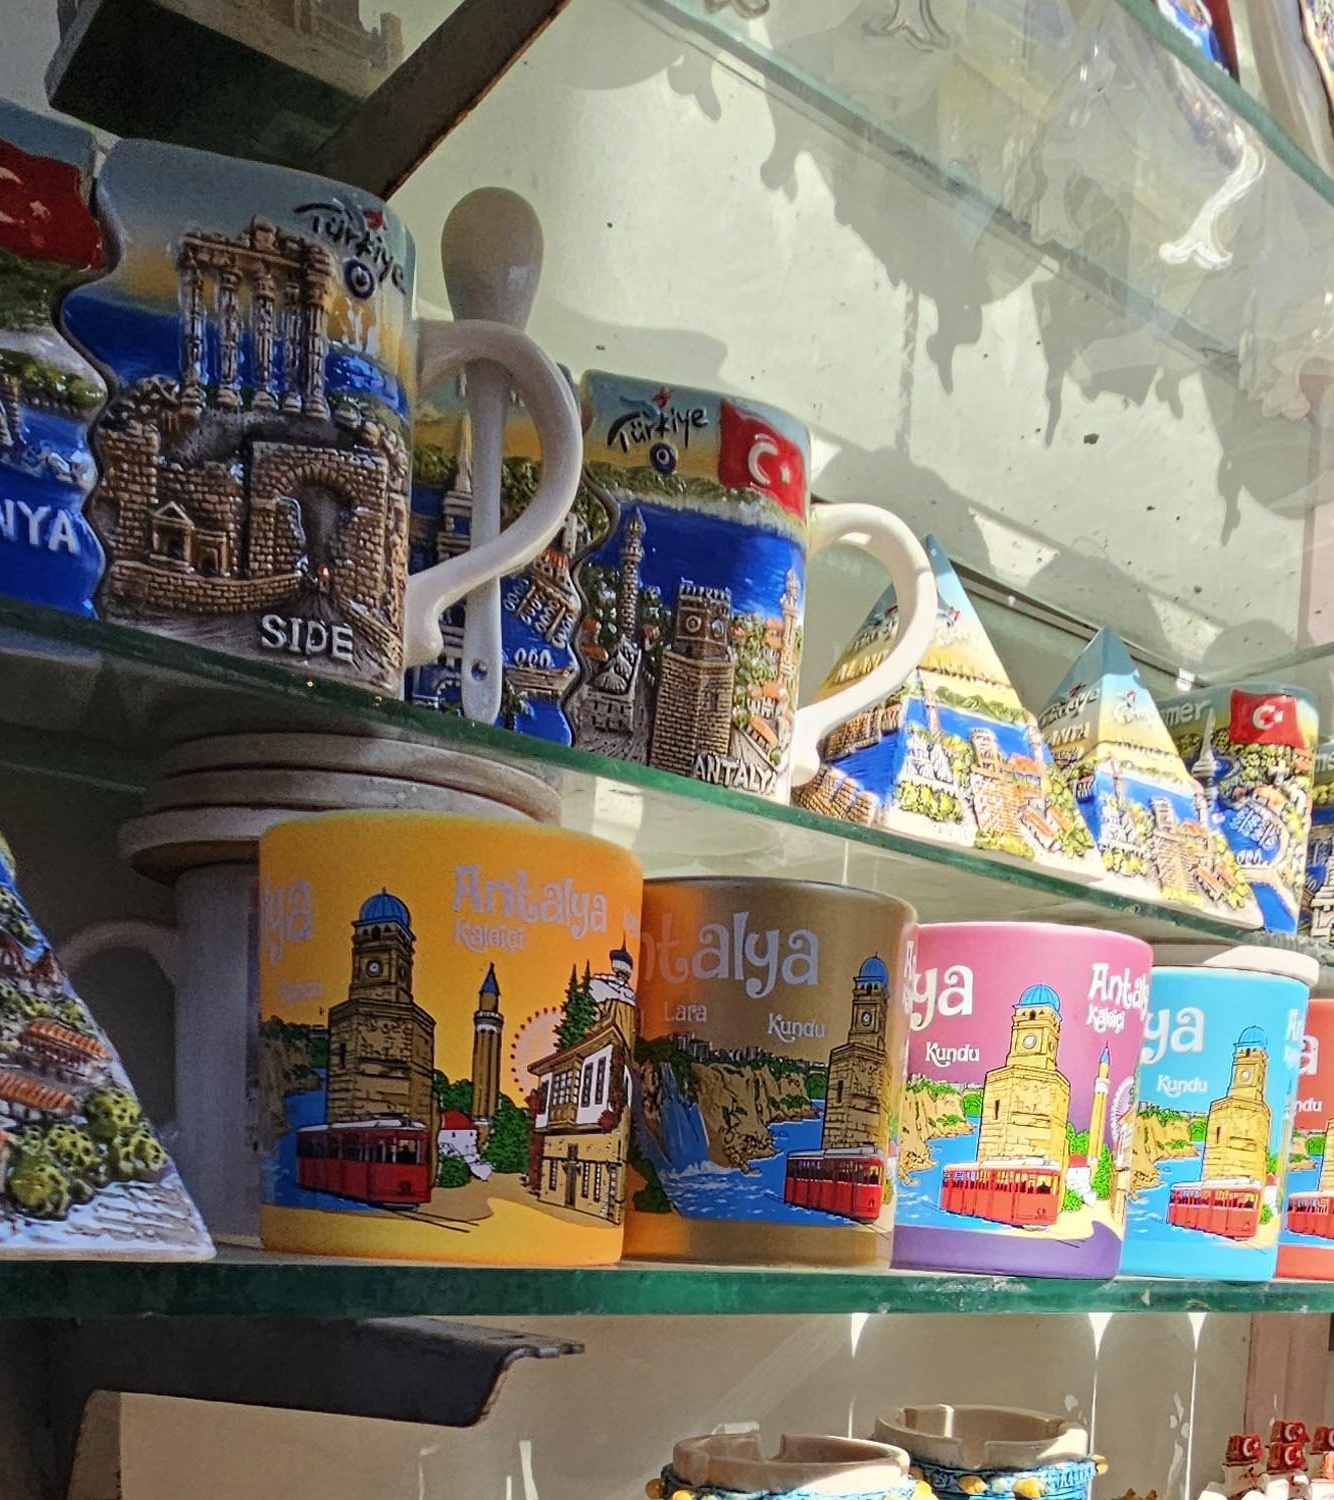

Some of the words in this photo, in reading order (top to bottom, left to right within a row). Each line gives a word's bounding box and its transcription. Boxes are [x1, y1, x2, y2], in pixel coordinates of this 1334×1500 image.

[607, 408, 708, 453] Türkiye
[261, 613, 355, 663] SIDE
[451, 864, 608, 939] Antalya
[665, 1002, 708, 1023] Lara
[768, 1012, 826, 1044] Kundu
[925, 1041, 980, 1067] Kundu
[1156, 1073, 1208, 1098] Kundu
